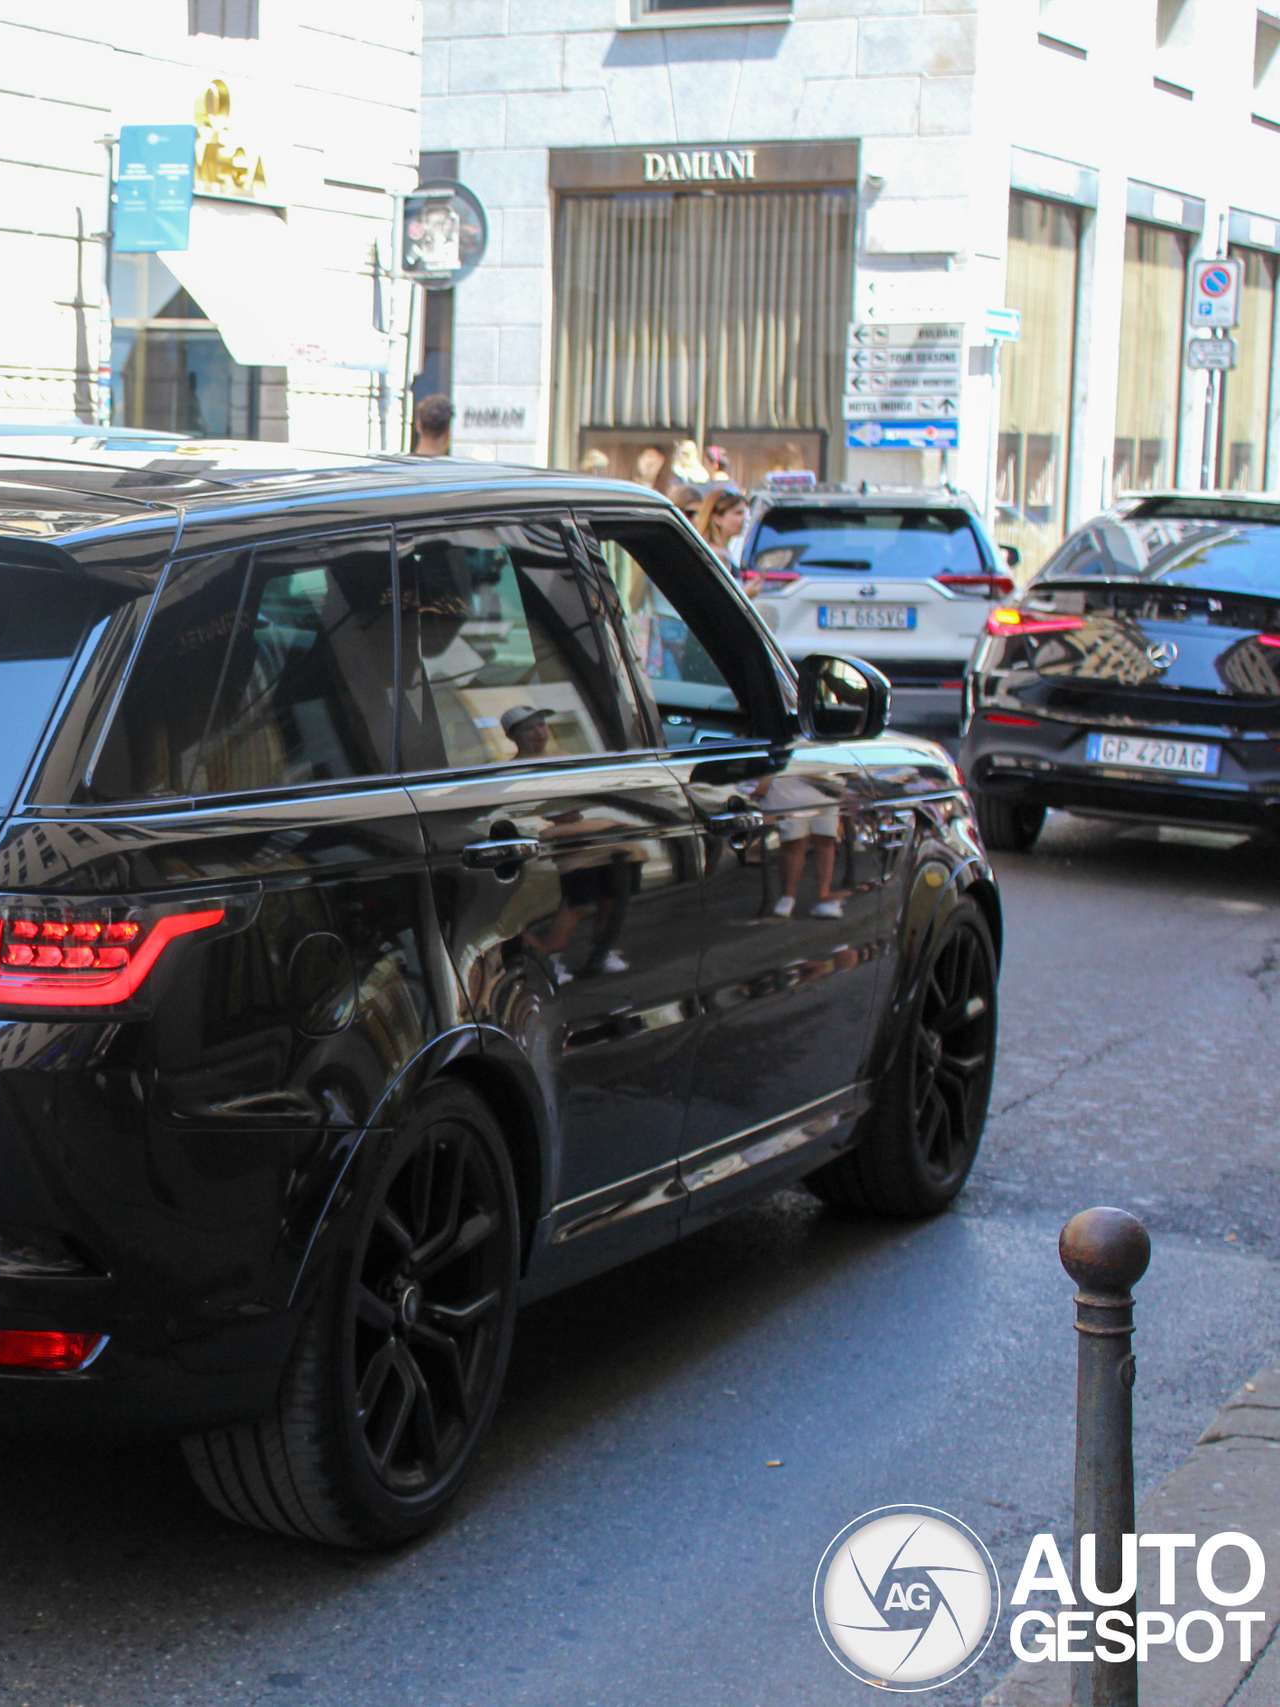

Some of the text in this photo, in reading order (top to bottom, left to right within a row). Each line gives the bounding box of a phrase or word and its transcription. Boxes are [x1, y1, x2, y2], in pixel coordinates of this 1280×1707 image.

[193, 140, 268, 190] MEGA
[643, 149, 756, 181] DAMIANI
[890, 352, 956, 363] FOUR SEASONS
[848, 400, 913, 412] HOTEL INDIGO
[830, 608, 848, 626] FY
[1102, 738, 1204, 769] GP 420AG
